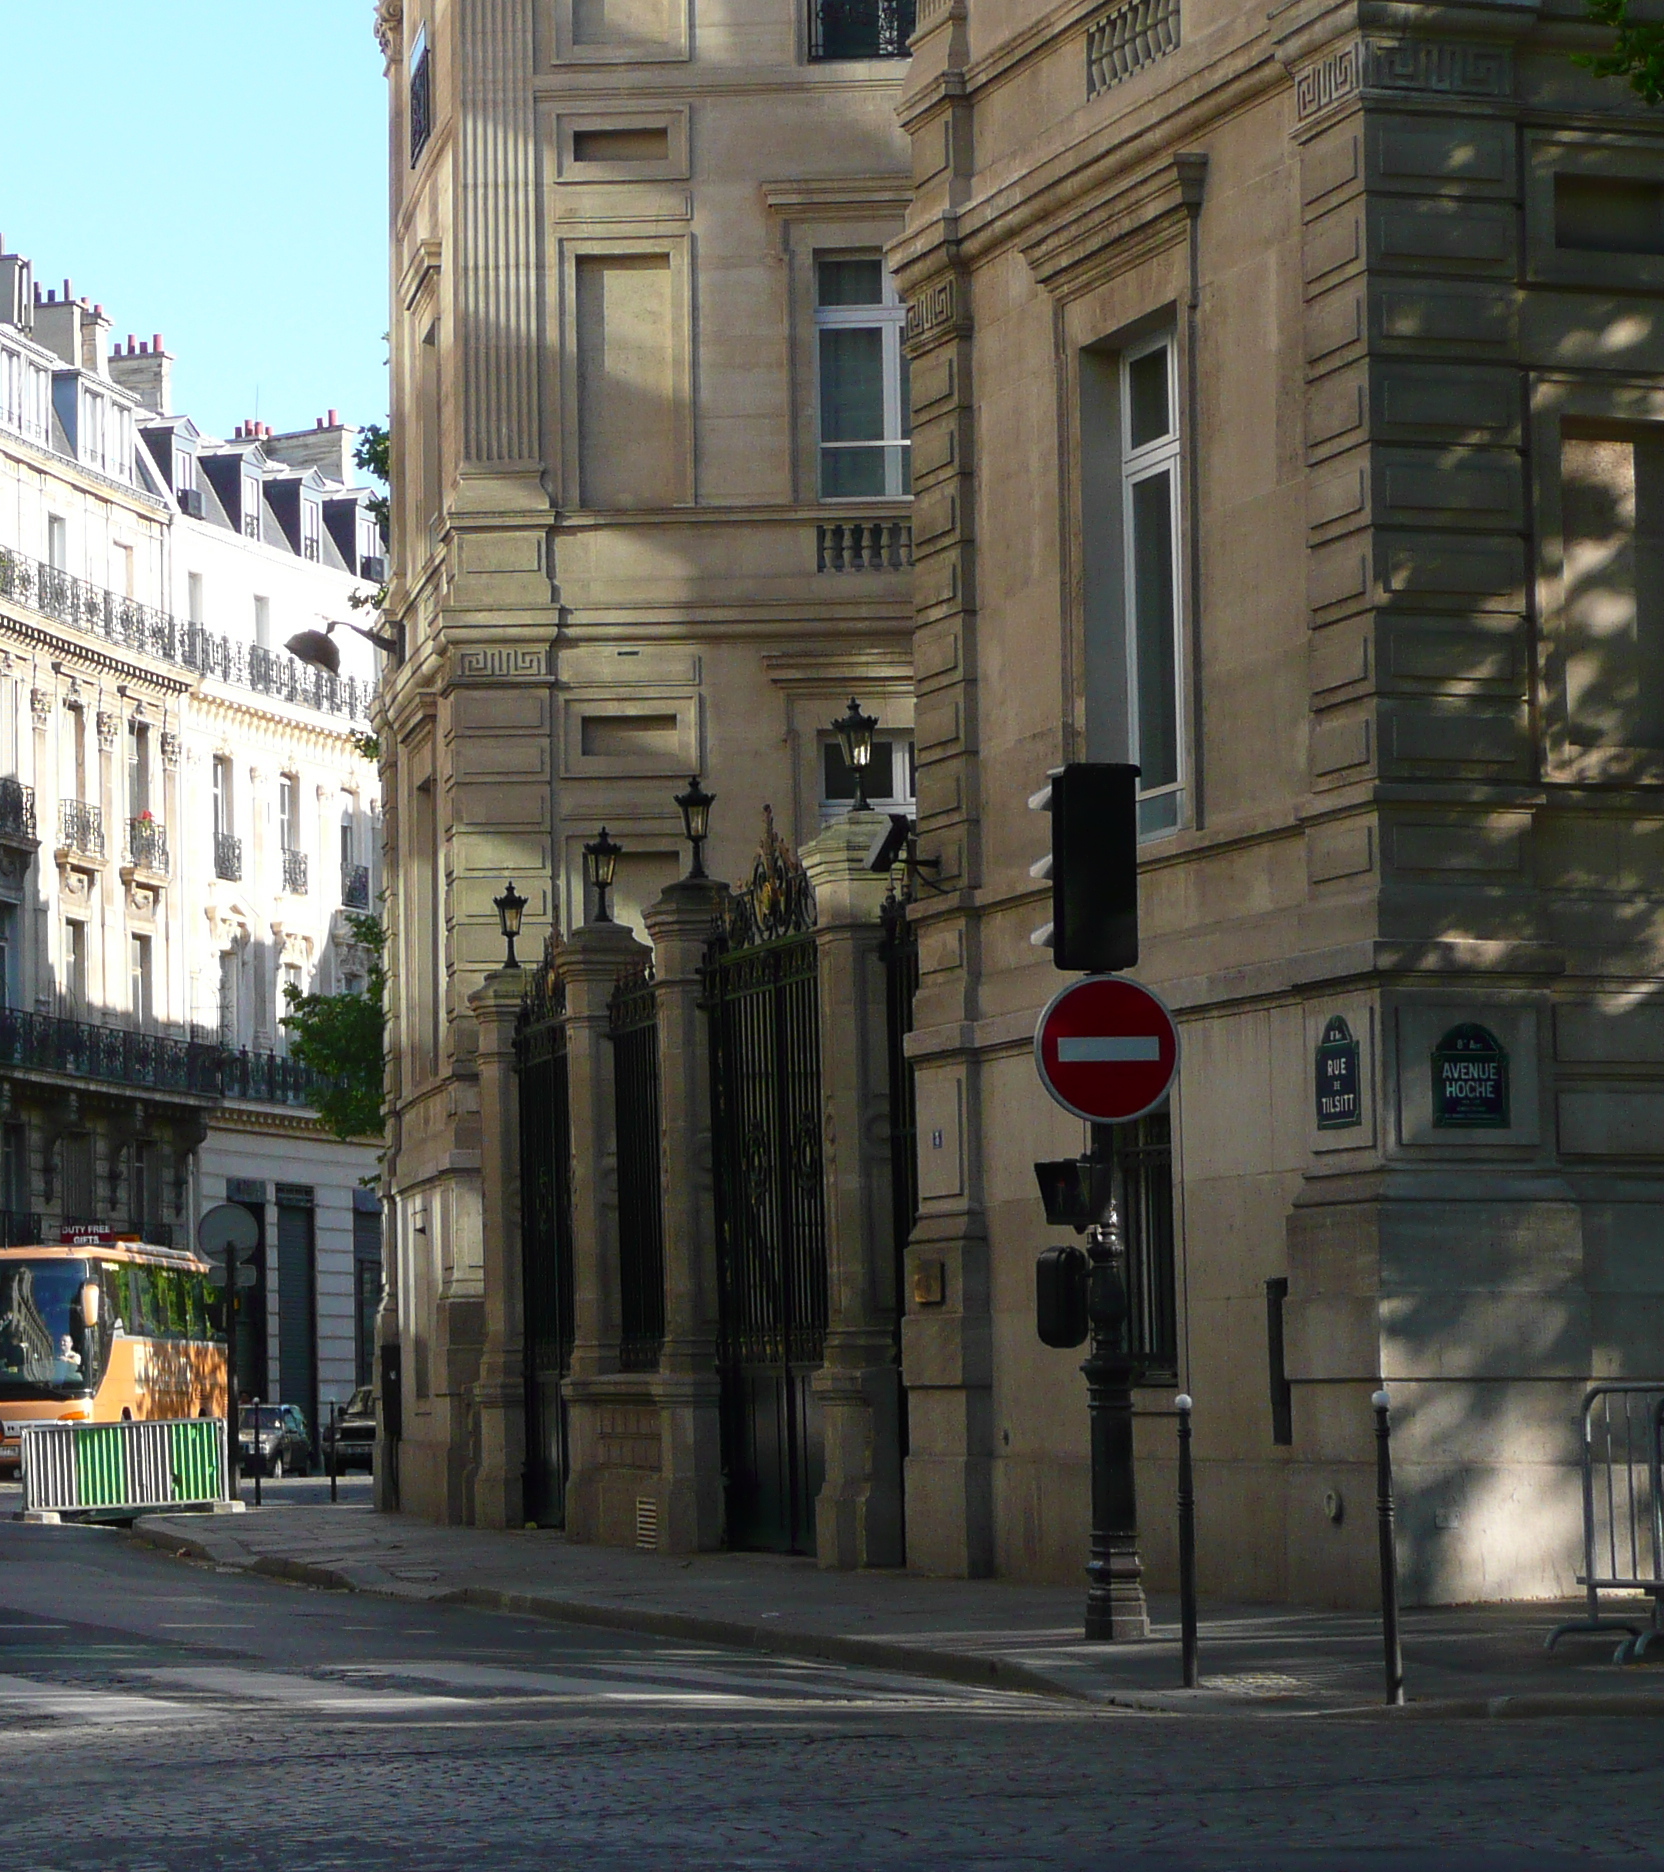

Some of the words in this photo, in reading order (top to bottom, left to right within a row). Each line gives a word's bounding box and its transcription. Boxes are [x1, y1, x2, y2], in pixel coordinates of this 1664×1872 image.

[1327, 1058, 1347, 1076] RUE
[1442, 1062, 1498, 1079] AVENUE
[1446, 1081, 1495, 1098] HOCHE
[1321, 1094, 1354, 1114] TILSITT
[62, 1225, 86, 1234] DUTY
[88, 1225, 111, 1234] FREE
[73, 1235, 100, 1245] GIFTS
